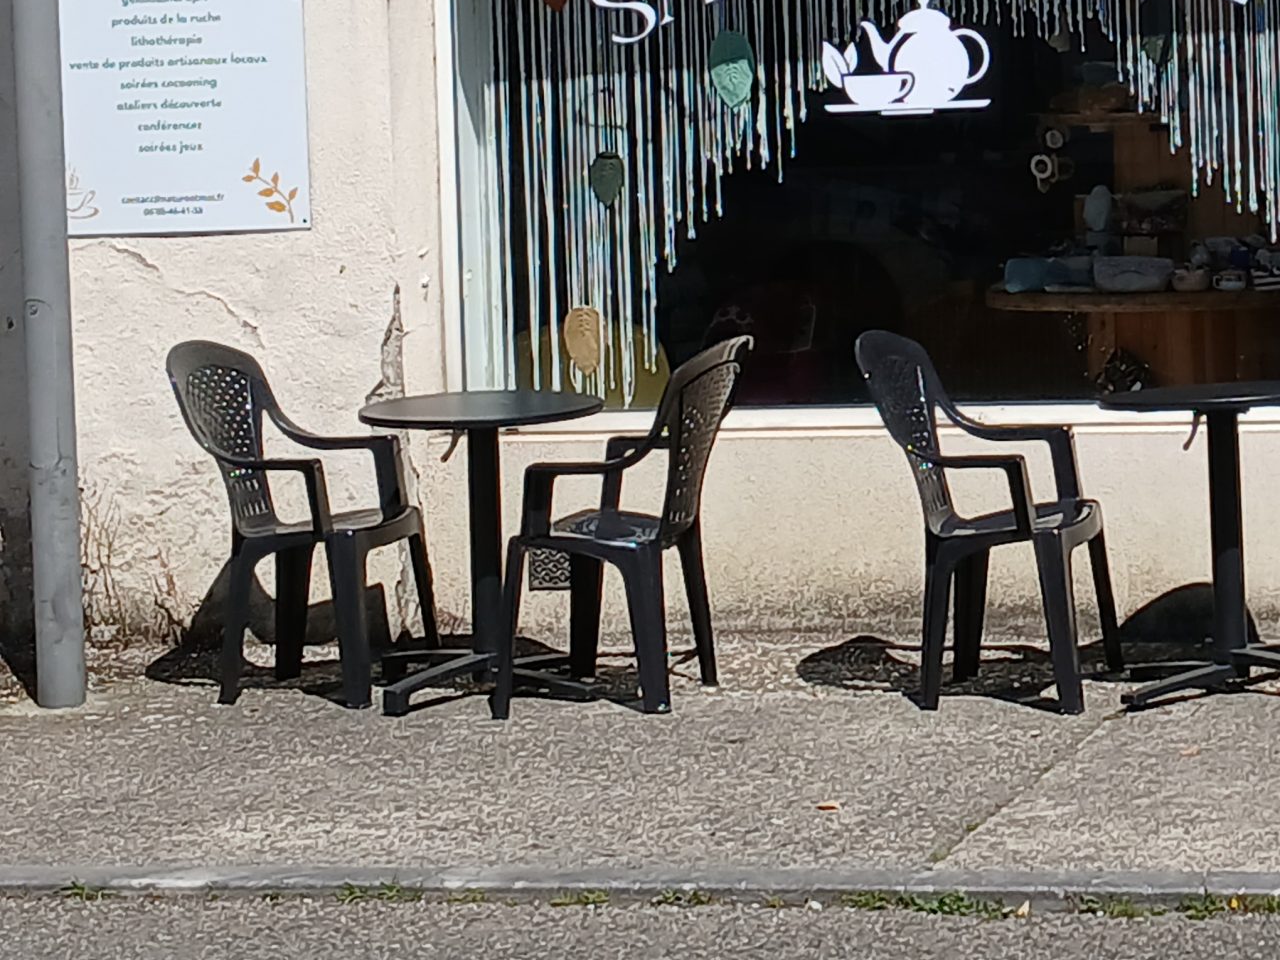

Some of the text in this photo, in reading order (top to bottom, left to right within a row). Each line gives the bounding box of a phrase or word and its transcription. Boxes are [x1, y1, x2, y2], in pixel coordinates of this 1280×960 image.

[111, 15, 158, 29] produits
[160, 14, 174, 25] de
[176, 13, 188, 24] la
[102, 58, 116, 70] de
